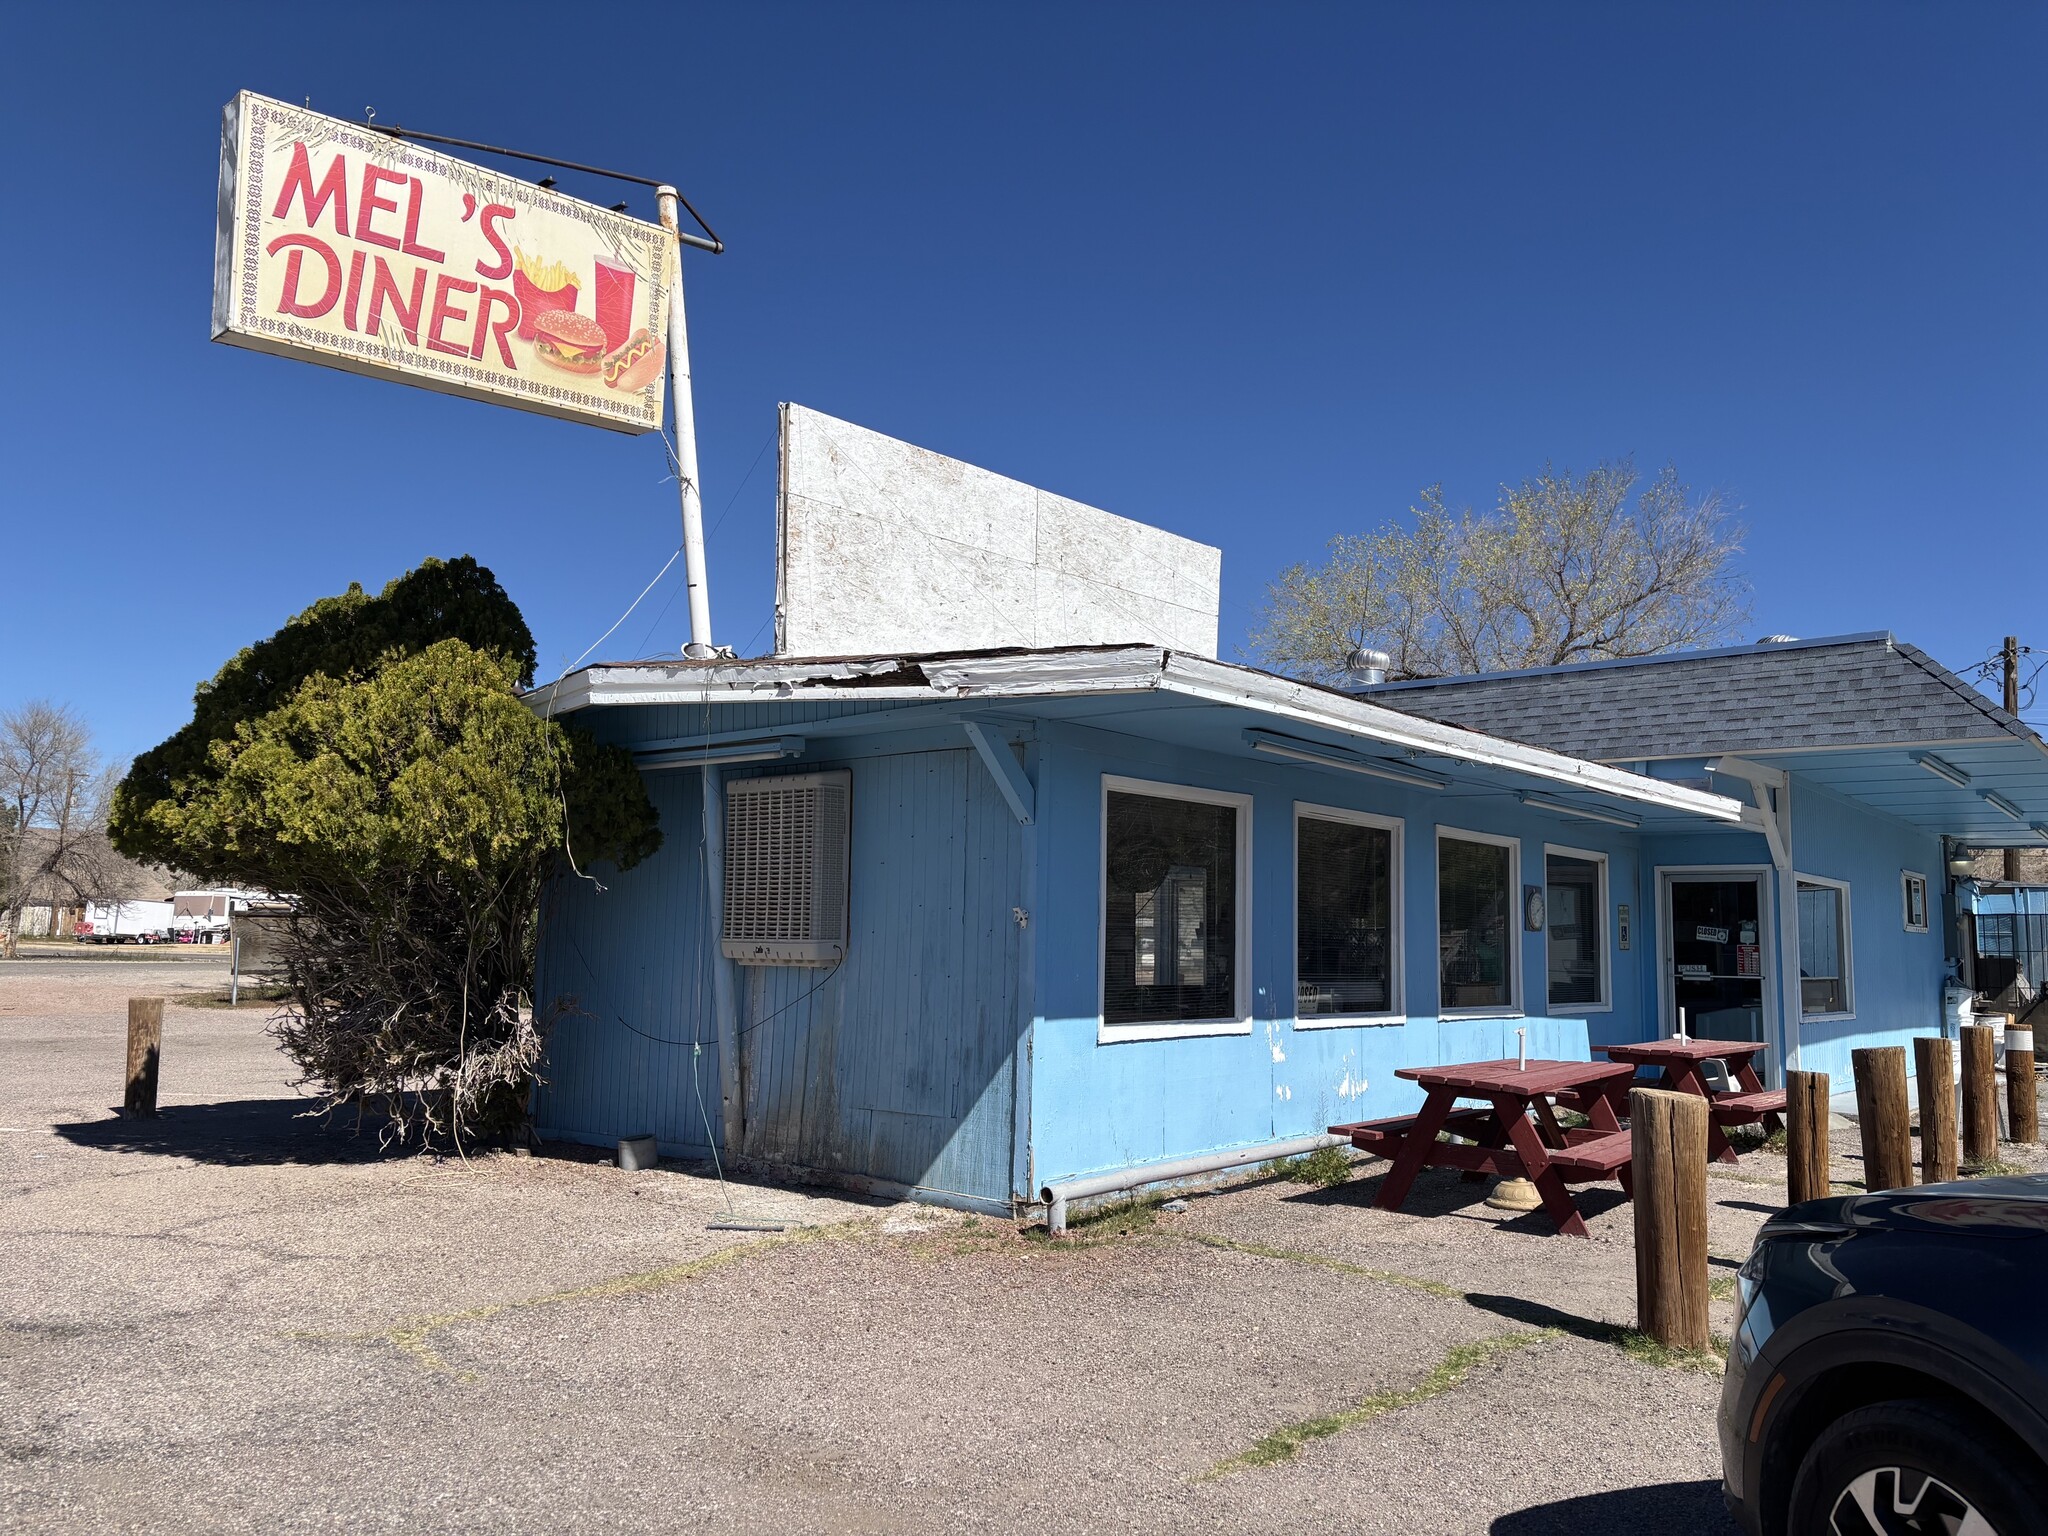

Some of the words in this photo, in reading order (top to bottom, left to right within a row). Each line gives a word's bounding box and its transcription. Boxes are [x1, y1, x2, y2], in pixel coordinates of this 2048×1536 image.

[271, 141, 516, 280] MEL'S
[265, 233, 523, 370] DINER
[1698, 926, 1717, 936] CLOSED
